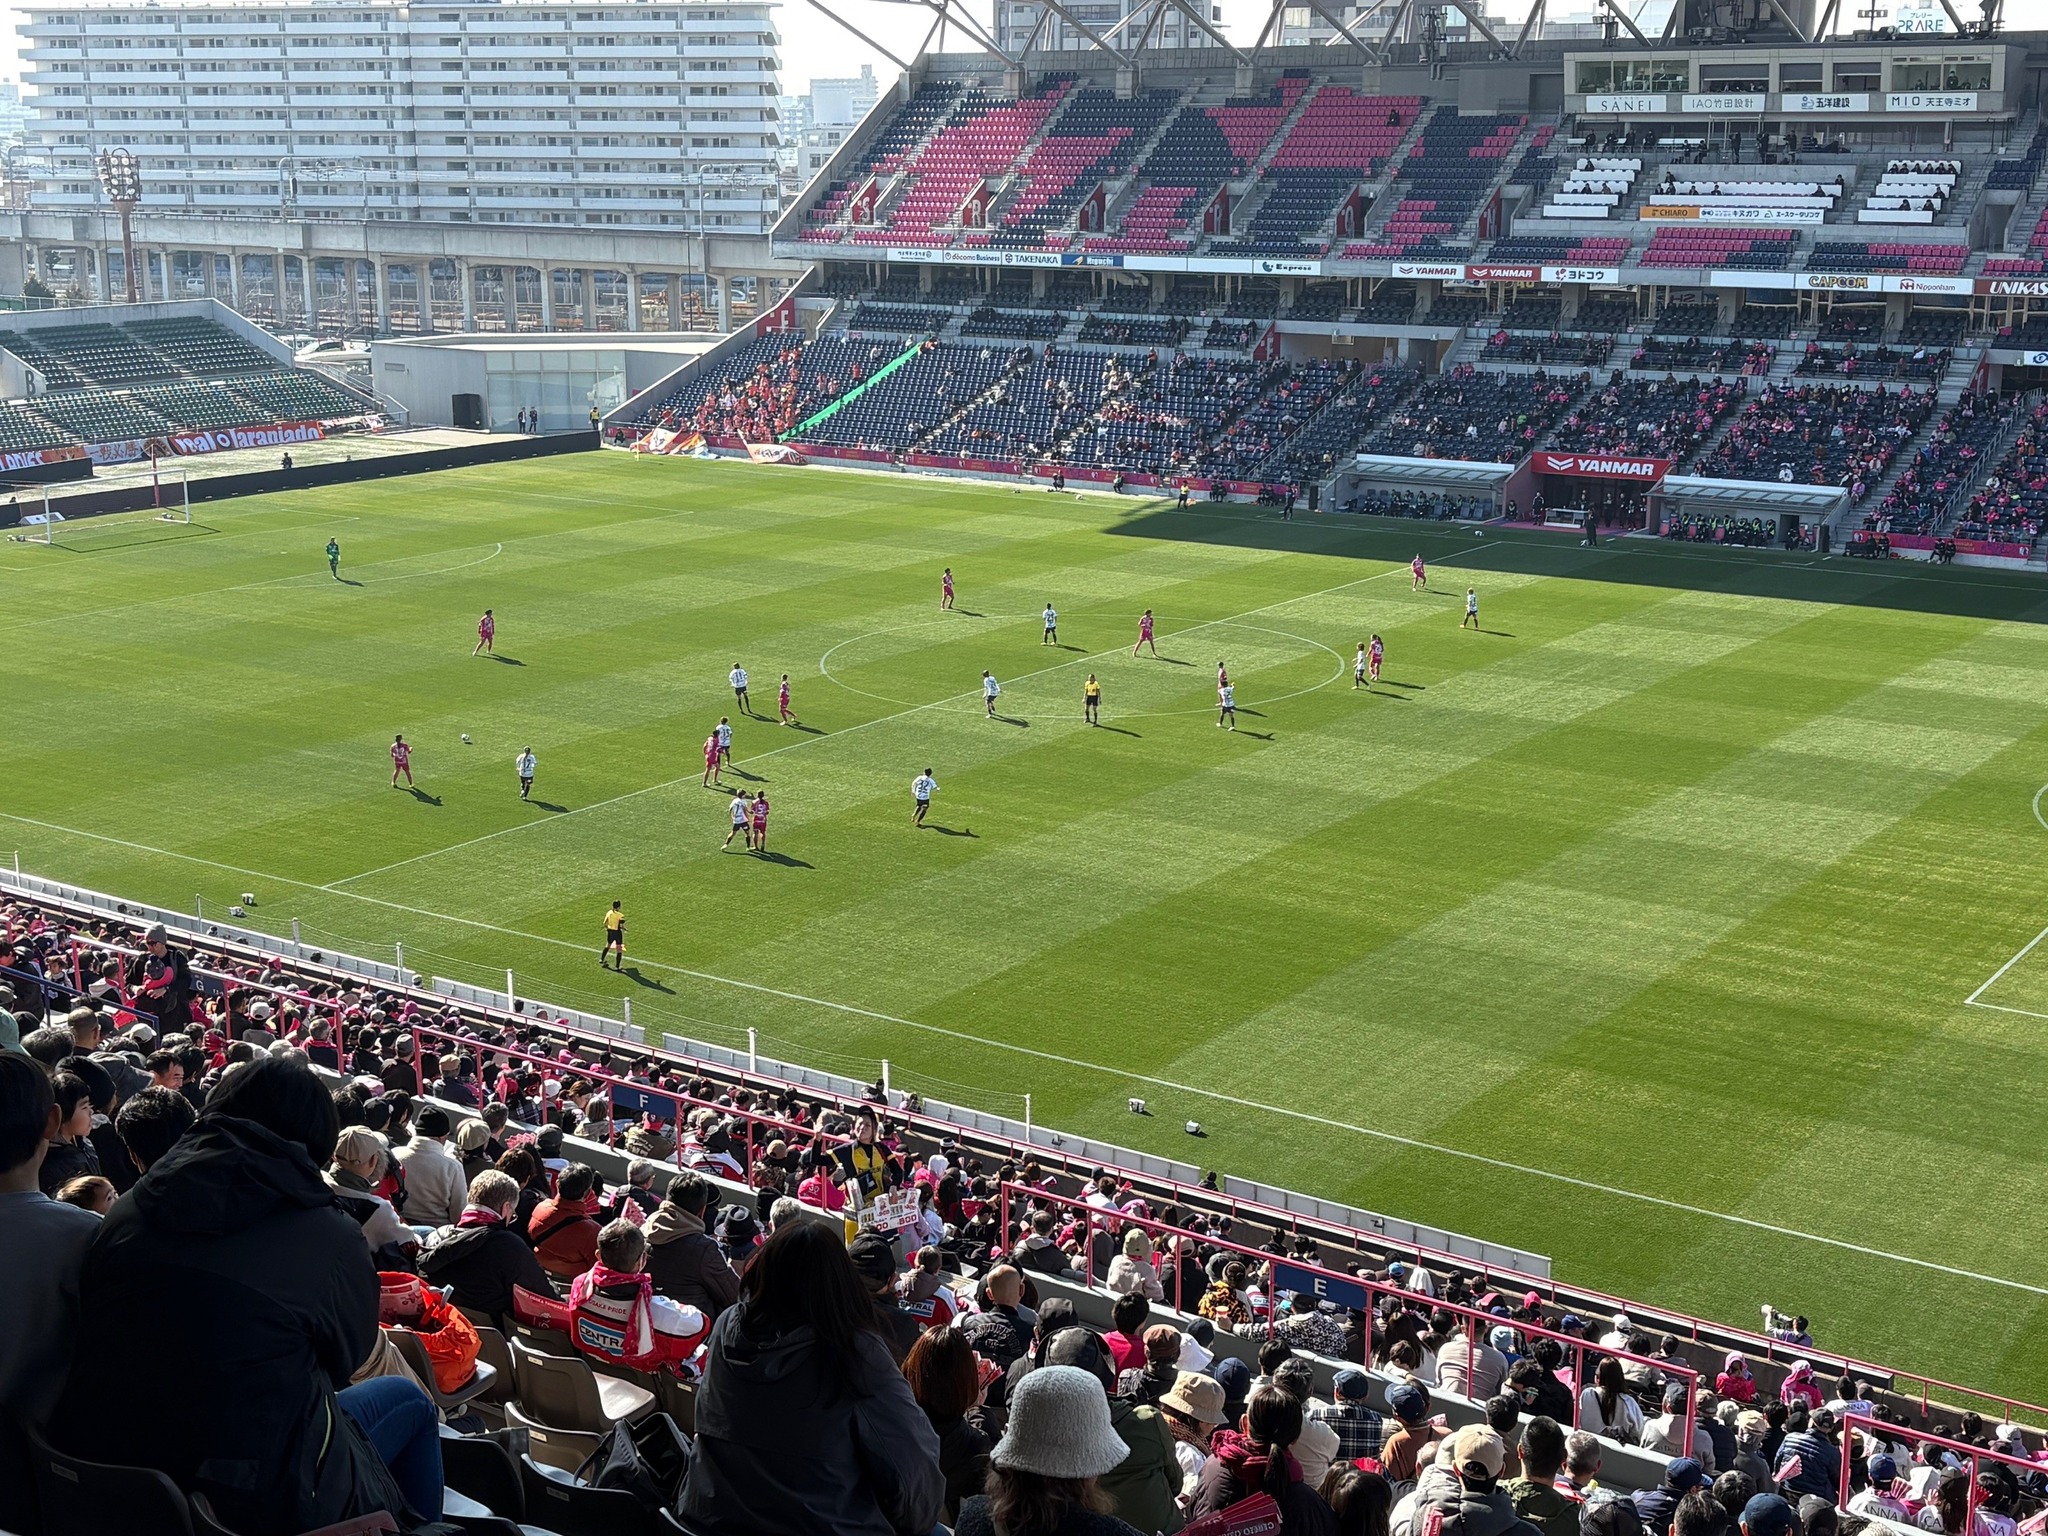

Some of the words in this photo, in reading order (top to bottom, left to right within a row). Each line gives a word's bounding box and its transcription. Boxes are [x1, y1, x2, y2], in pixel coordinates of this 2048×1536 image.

[1898, 19, 1944, 32] PRARE
[1600, 100, 1652, 112] SANEI
[1692, 98, 1754, 109] IAO竹田設計
[1816, 97, 1850, 108] 五洋建設
[1891, 96, 1921, 107] MIO
[1660, 209, 1688, 217] CHIARO
[976, 254, 1000, 262] Business
[1015, 255, 1059, 264] TAKENAKA
[1415, 267, 1458, 276] YANMAR
[1489, 269, 1533, 278] YANMAR
[1568, 271, 1605, 280] ヨドコウ
[1808, 275, 1869, 289] CAPCOM
[1577, 458, 1655, 476] YANMAR
[195, 980, 205, 991] G
[639, 1094, 649, 1108] F
[1313, 1277, 1328, 1297] E
[607, 1304, 627, 1316] PRIDE
[580, 1325, 624, 1348] CENTR
